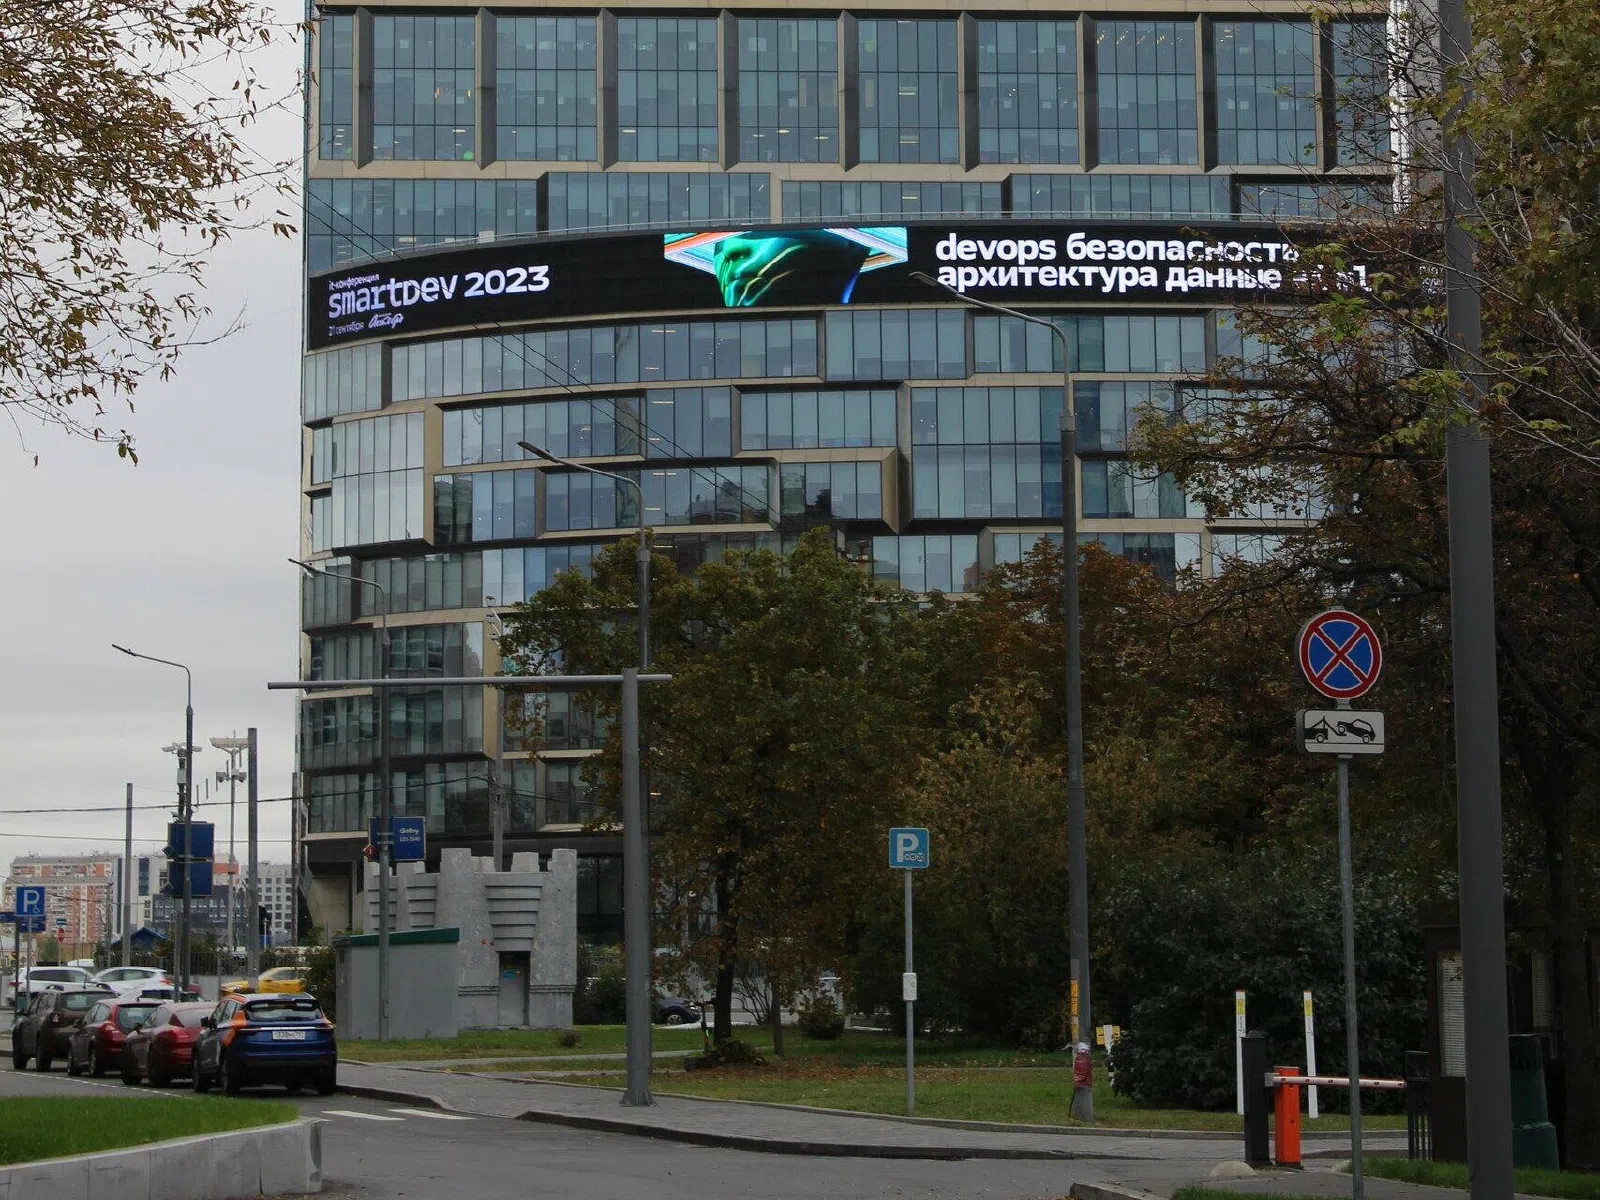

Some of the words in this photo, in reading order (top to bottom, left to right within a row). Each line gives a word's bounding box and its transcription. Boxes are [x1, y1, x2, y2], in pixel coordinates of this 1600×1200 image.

[935, 233, 1056, 268] devops
[1066, 232, 1300, 264] безопасность
[464, 265, 550, 298] 2023
[937, 263, 1158, 294] архитектура
[1165, 266, 1282, 294] данные
[896, 833, 919, 863] P
[23, 889, 40, 913] P
